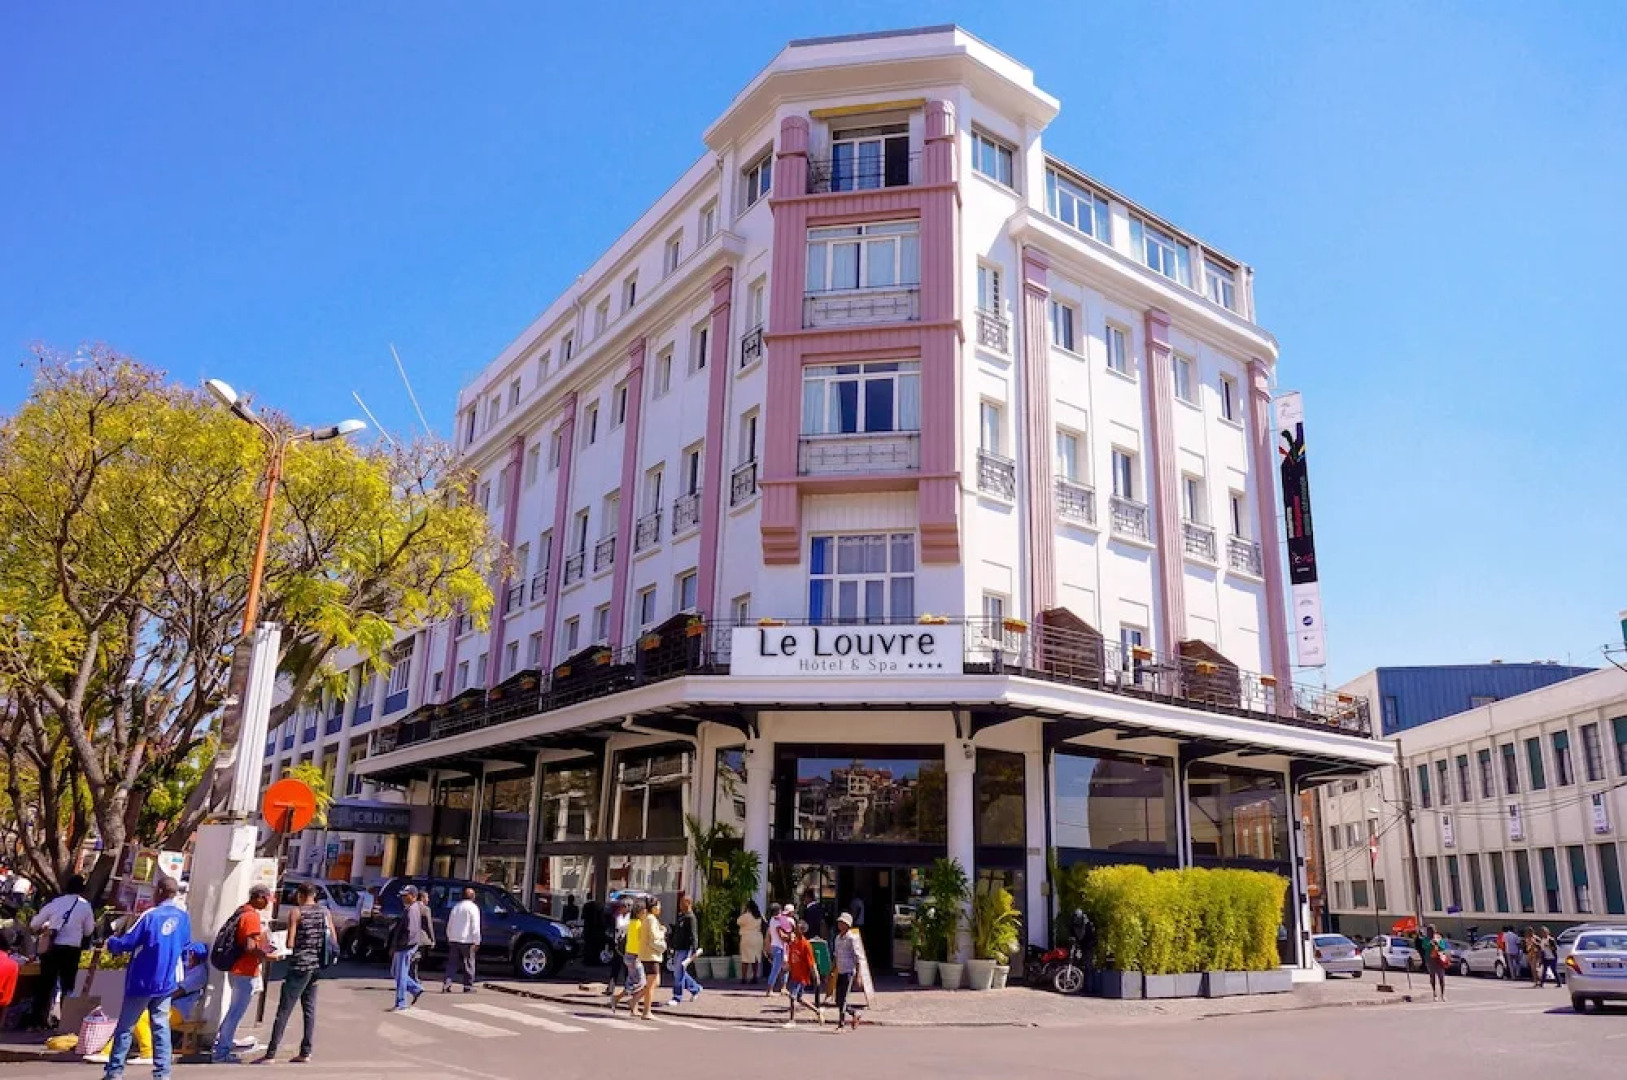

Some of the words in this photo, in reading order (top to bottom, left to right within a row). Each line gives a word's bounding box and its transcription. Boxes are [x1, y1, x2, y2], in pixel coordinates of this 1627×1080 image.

[758, 628, 797, 656] Le
[812, 628, 935, 656] Louvre
[799, 658, 842, 671] Hôtel
[850, 659, 860, 671] &
[868, 659, 898, 673] Spa
